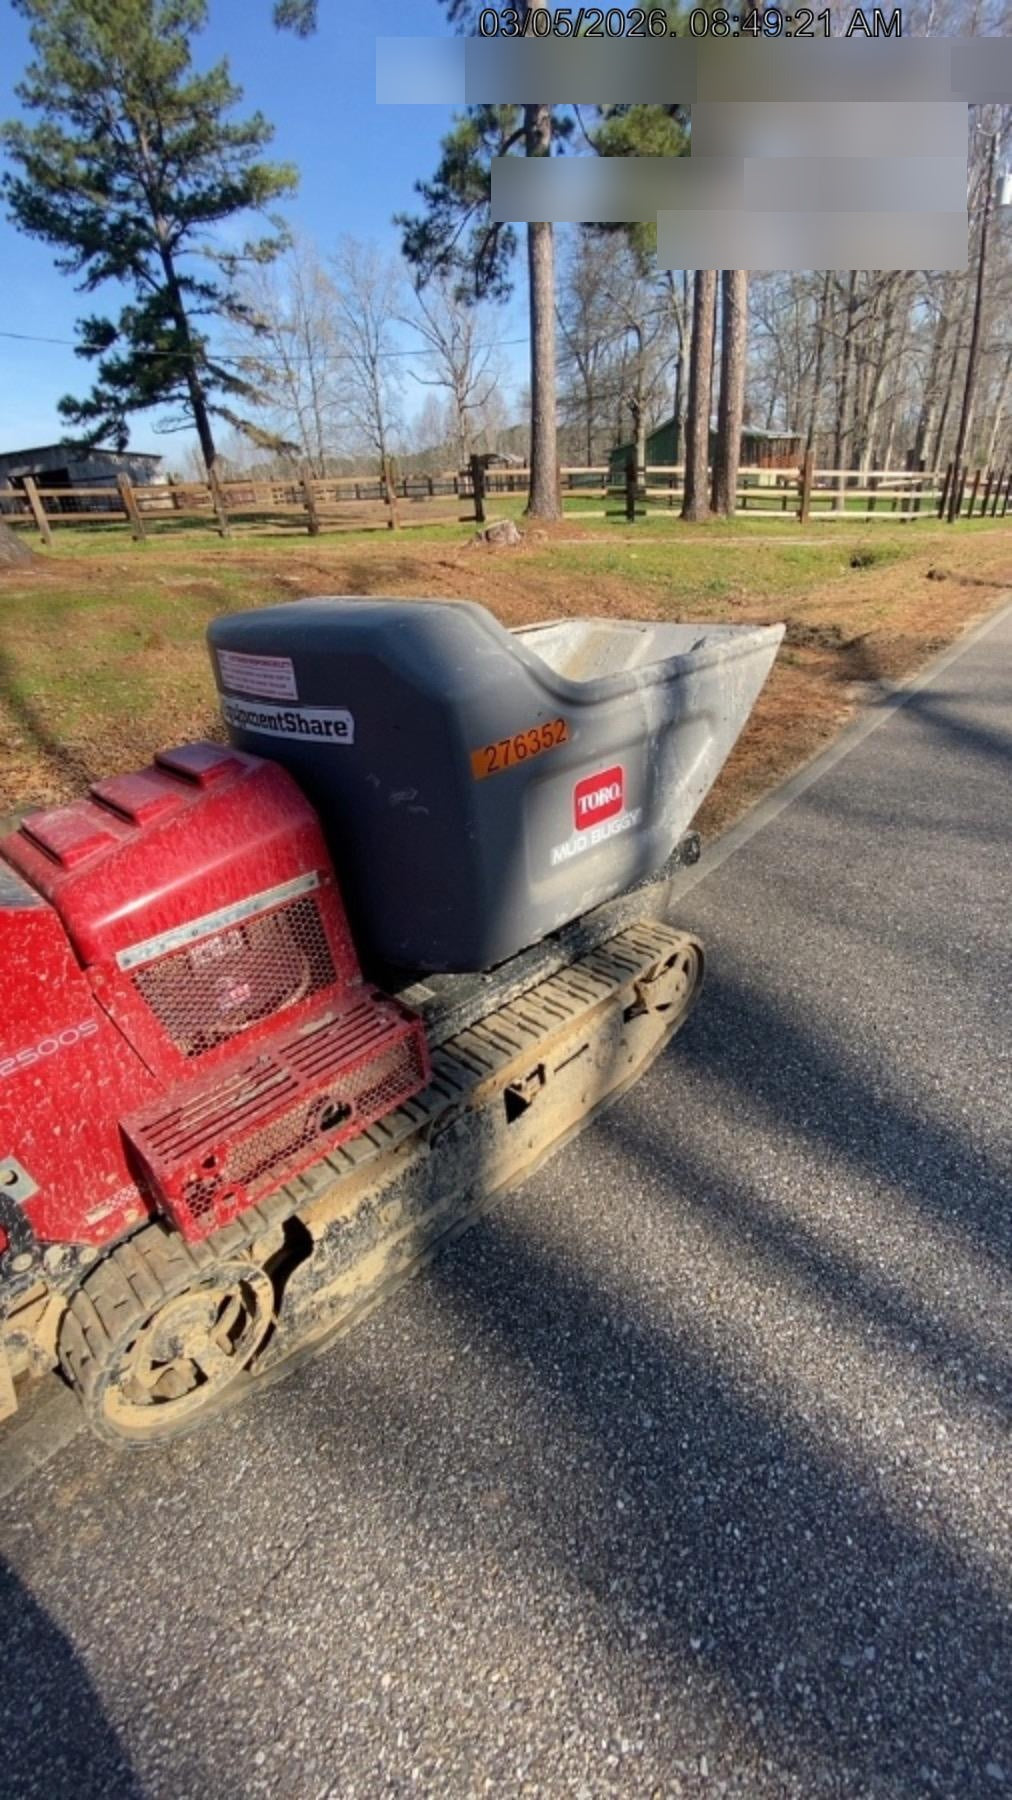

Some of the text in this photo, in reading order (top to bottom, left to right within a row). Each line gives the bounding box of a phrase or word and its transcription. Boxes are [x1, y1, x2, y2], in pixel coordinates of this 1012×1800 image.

[484, 717, 568, 773] 276352
[577, 782, 621, 814] TORO
[551, 807, 643, 867] MUD BUGGY
[0, 1018, 99, 1077] 2500S
